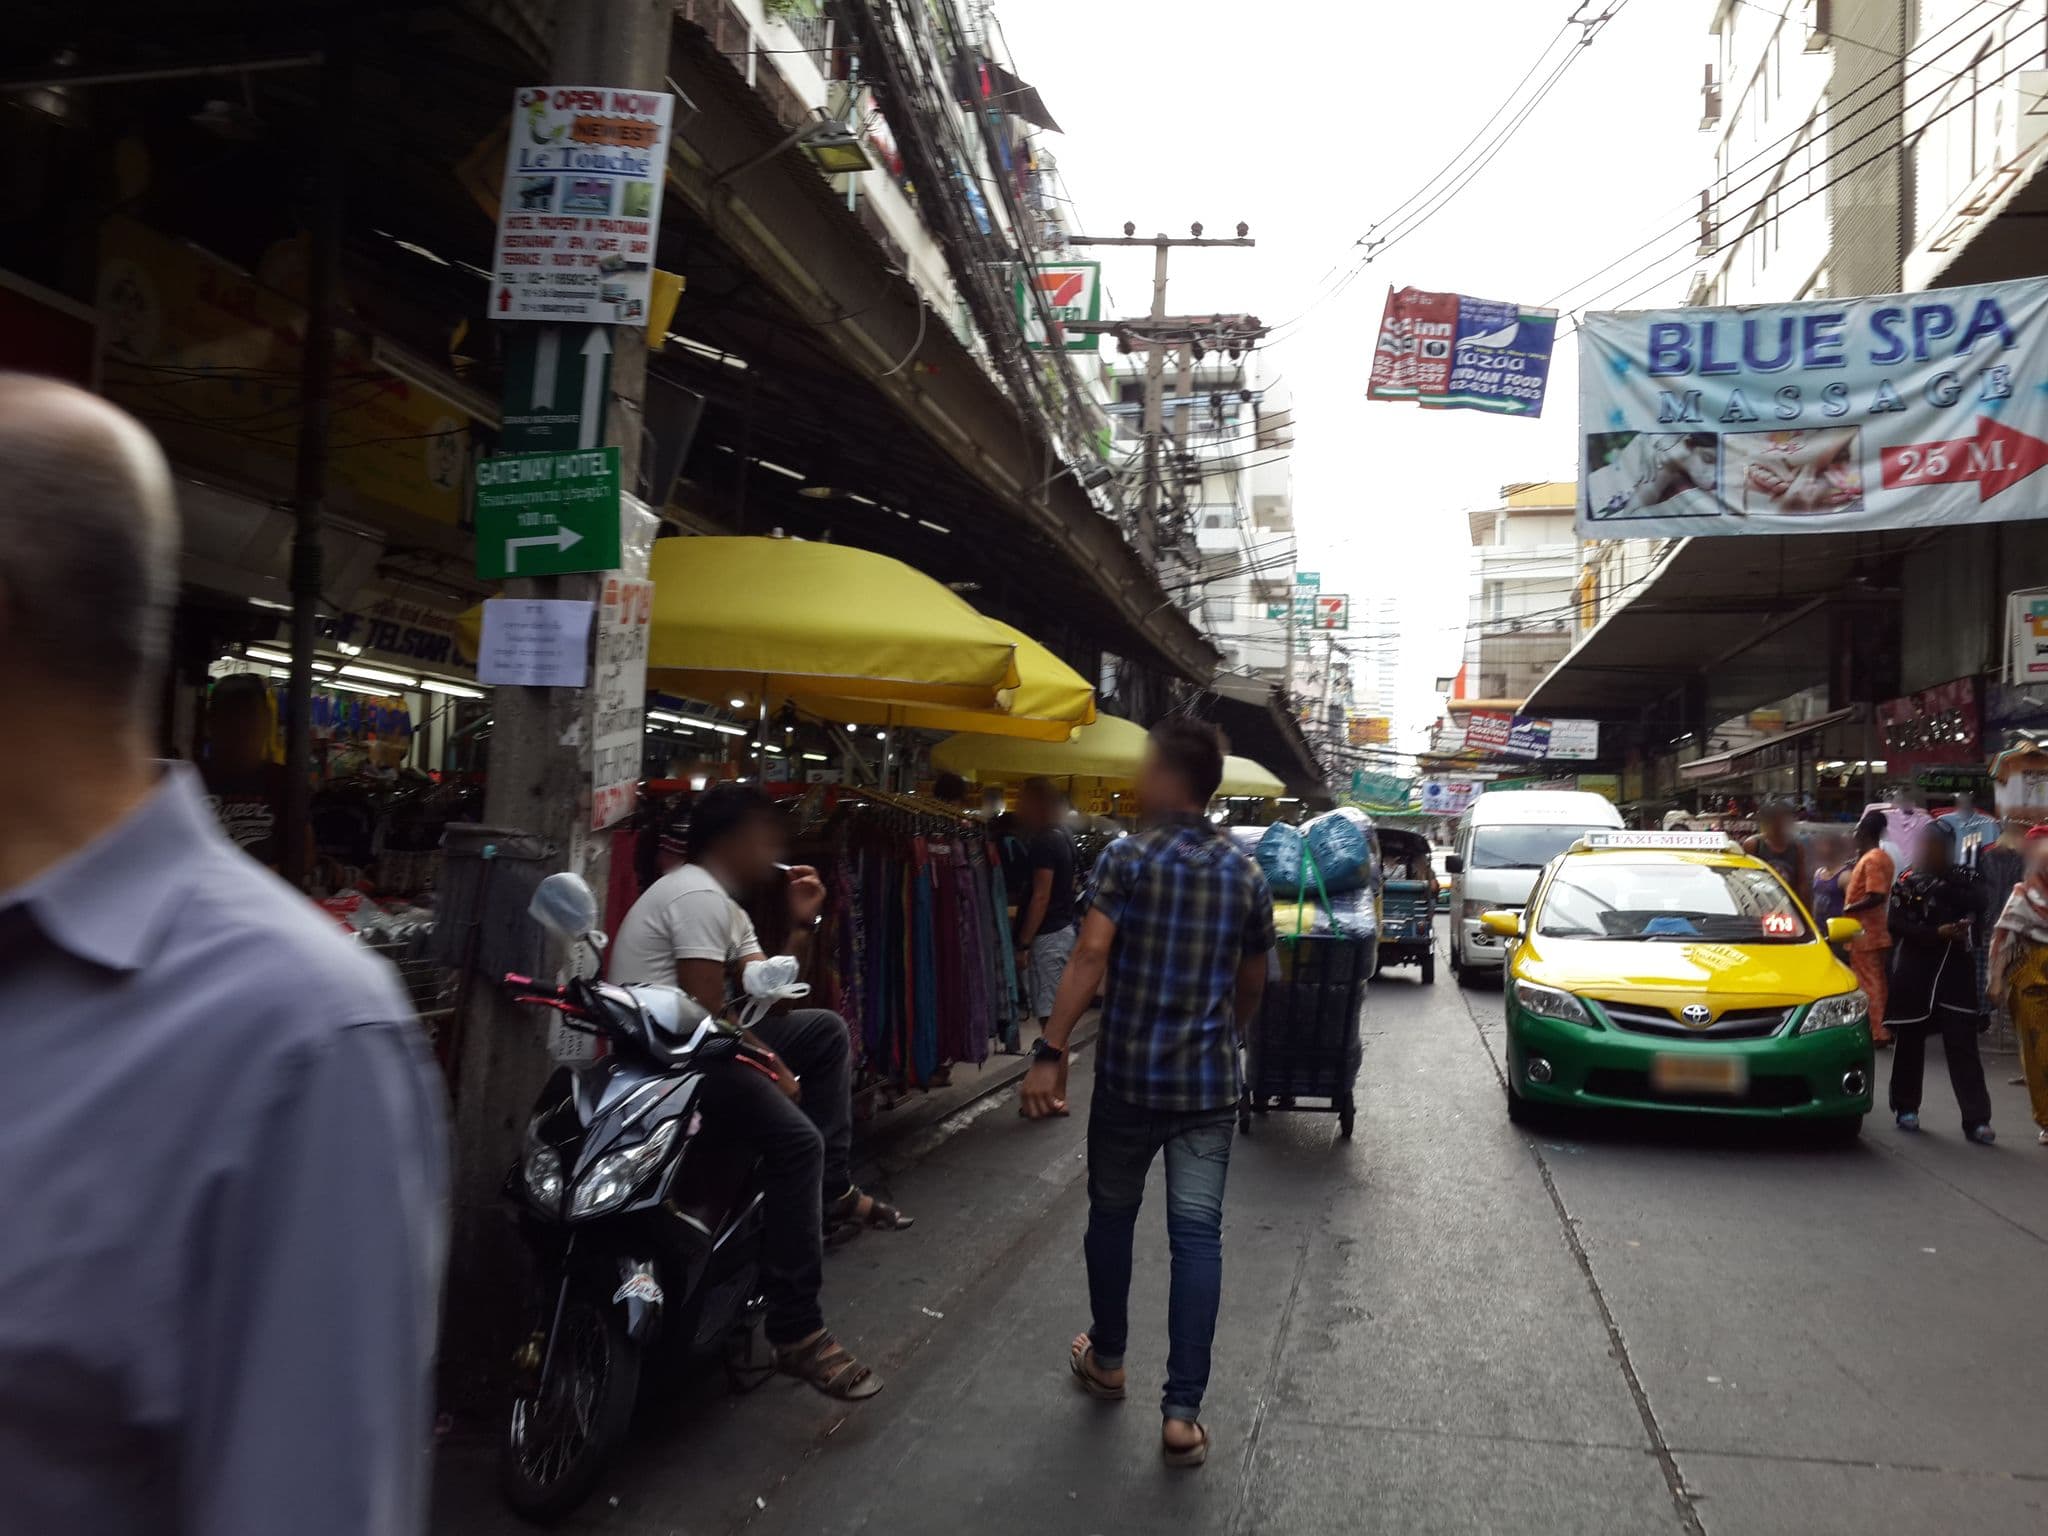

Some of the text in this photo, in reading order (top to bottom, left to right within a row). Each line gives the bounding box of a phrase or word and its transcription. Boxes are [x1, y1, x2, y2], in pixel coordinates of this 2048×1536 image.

[552, 90, 660, 114] OPEN NOW
[519, 147, 551, 168] Le
[1648, 298, 2017, 377] BLUE SPA
[1503, 373, 1543, 388] FOOD
[1657, 364, 2014, 424] MASSAGE
[476, 452, 613, 486] GATEWAY HOTEL
[1897, 440, 2018, 480] 25 M.
[1611, 834, 1722, 846] TAXI-METER
